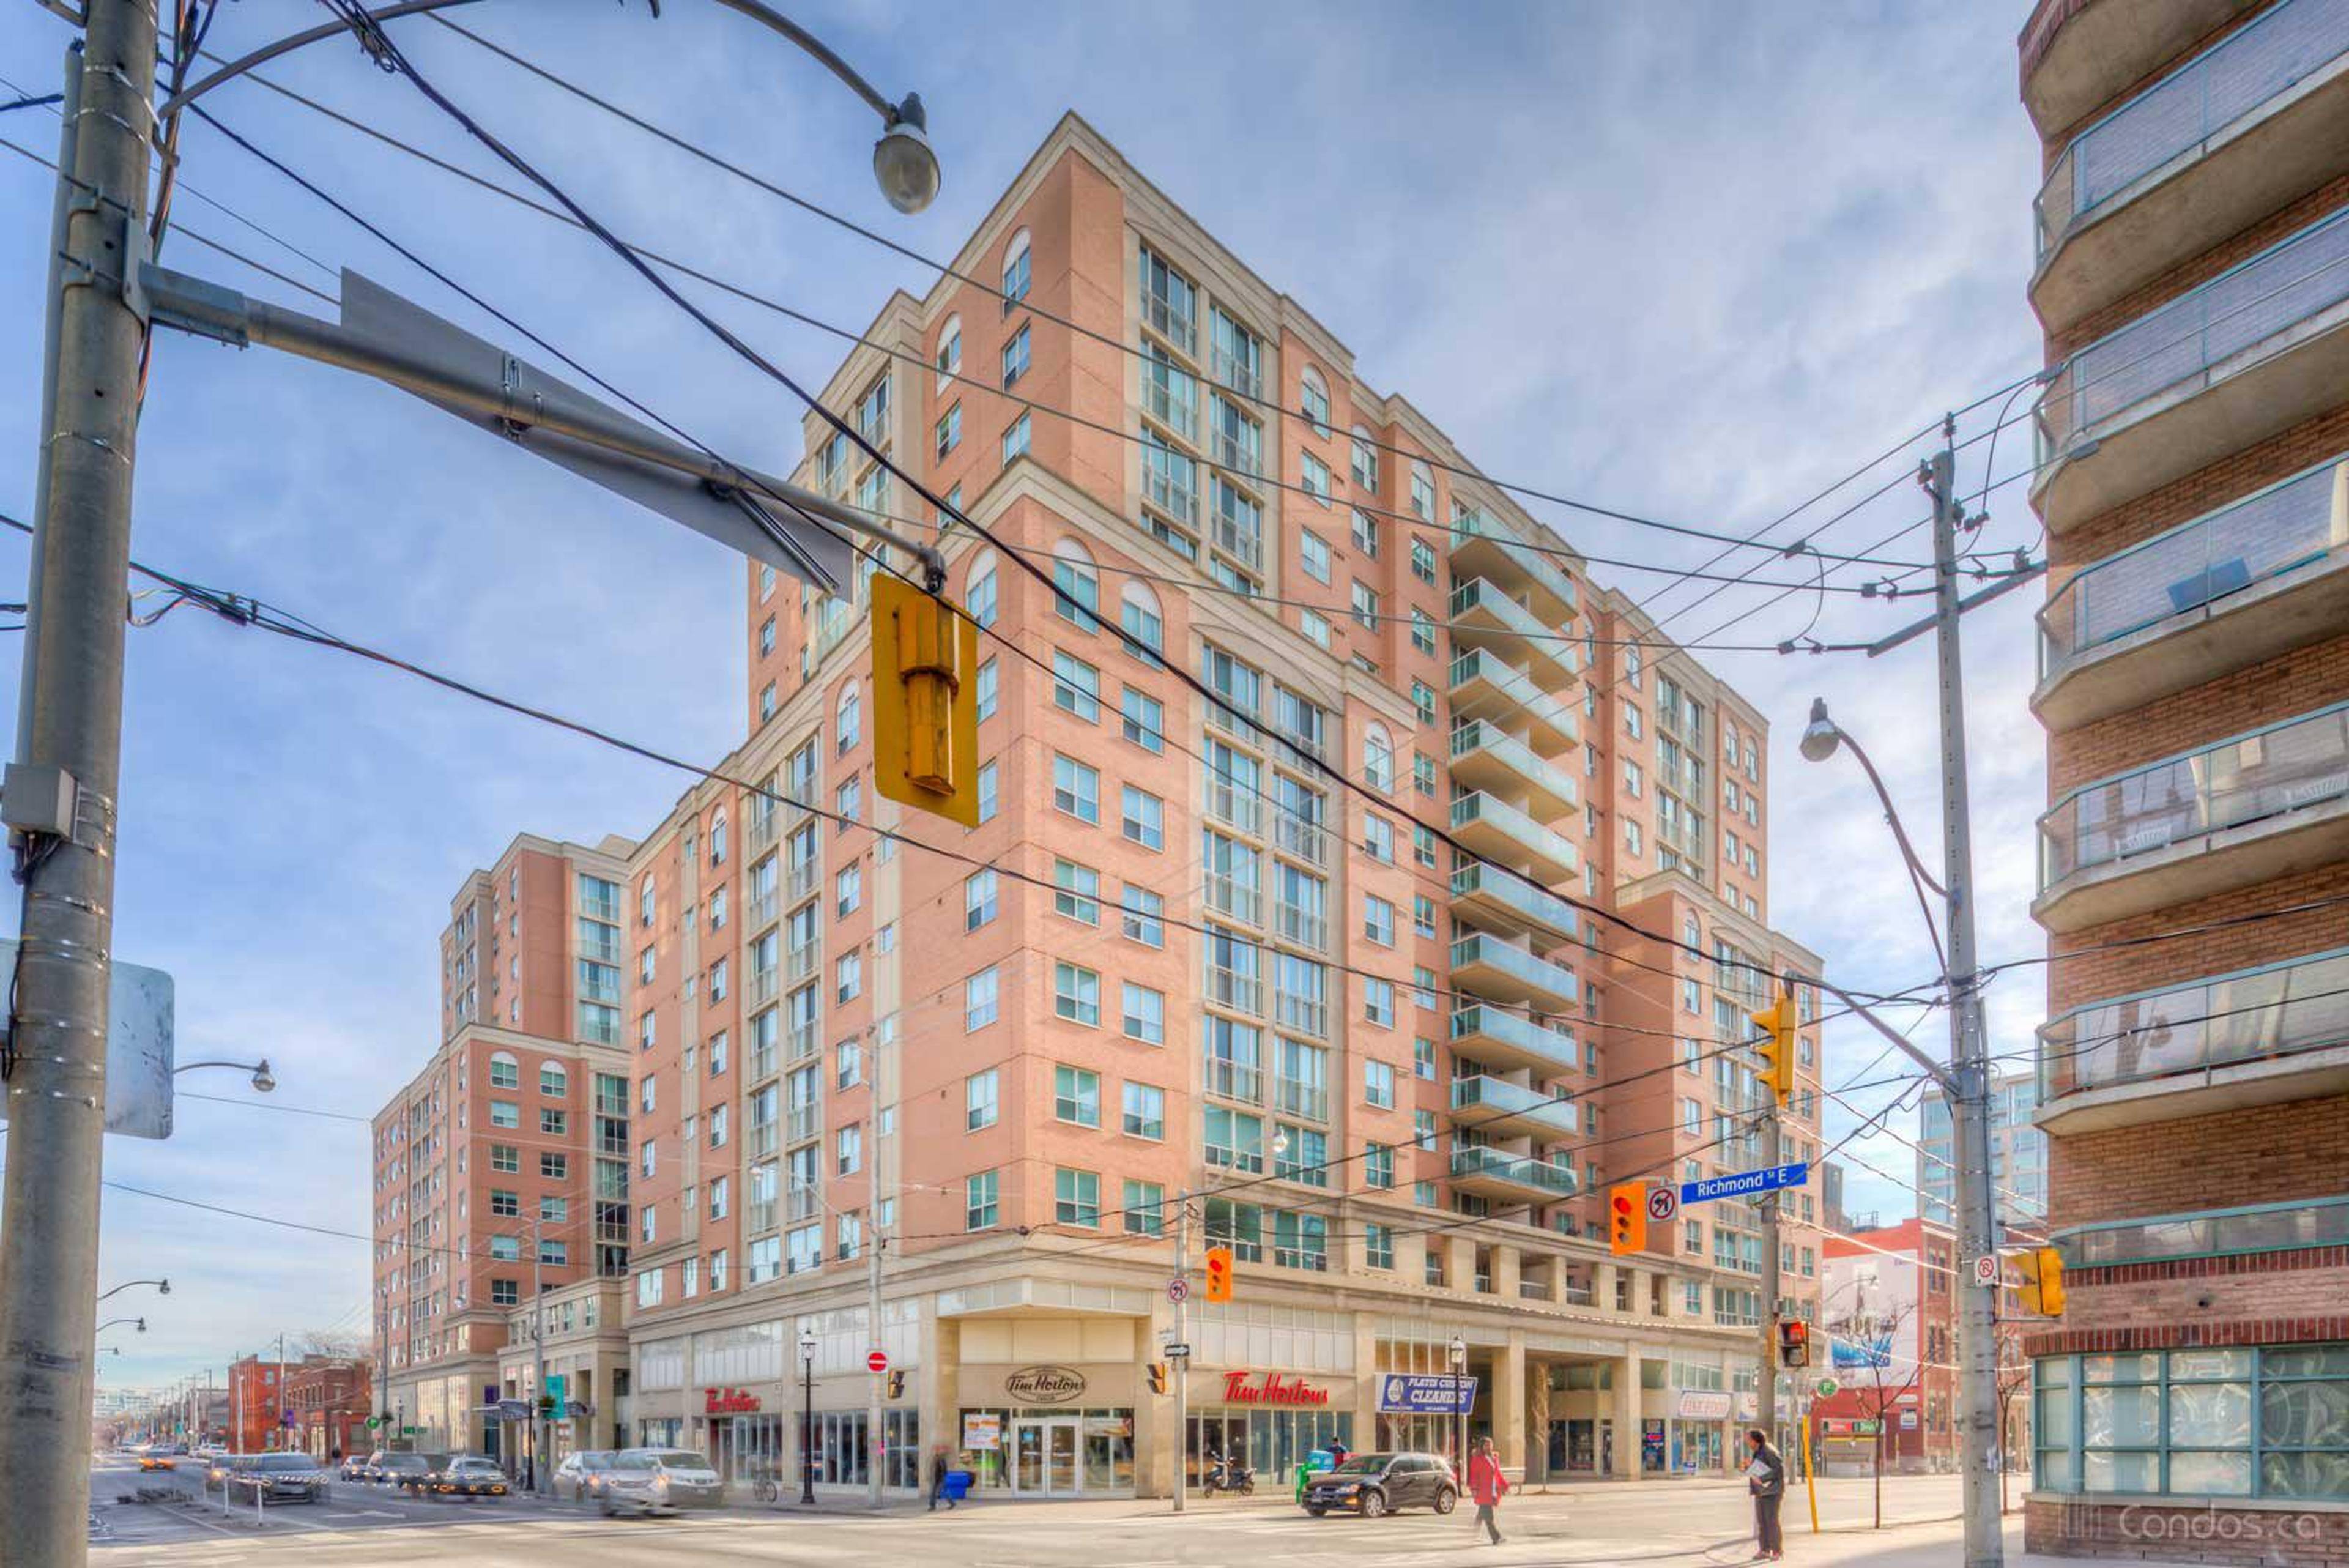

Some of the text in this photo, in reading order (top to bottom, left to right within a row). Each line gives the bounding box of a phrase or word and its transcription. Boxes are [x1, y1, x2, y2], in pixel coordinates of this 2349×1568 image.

[1698, 1173, 1764, 1197] Richmond
[1778, 1169, 1787, 1183] E
[1009, 1374, 1086, 1391] Tim Hortons
[1225, 1370, 1329, 1405] Tim Hortons
